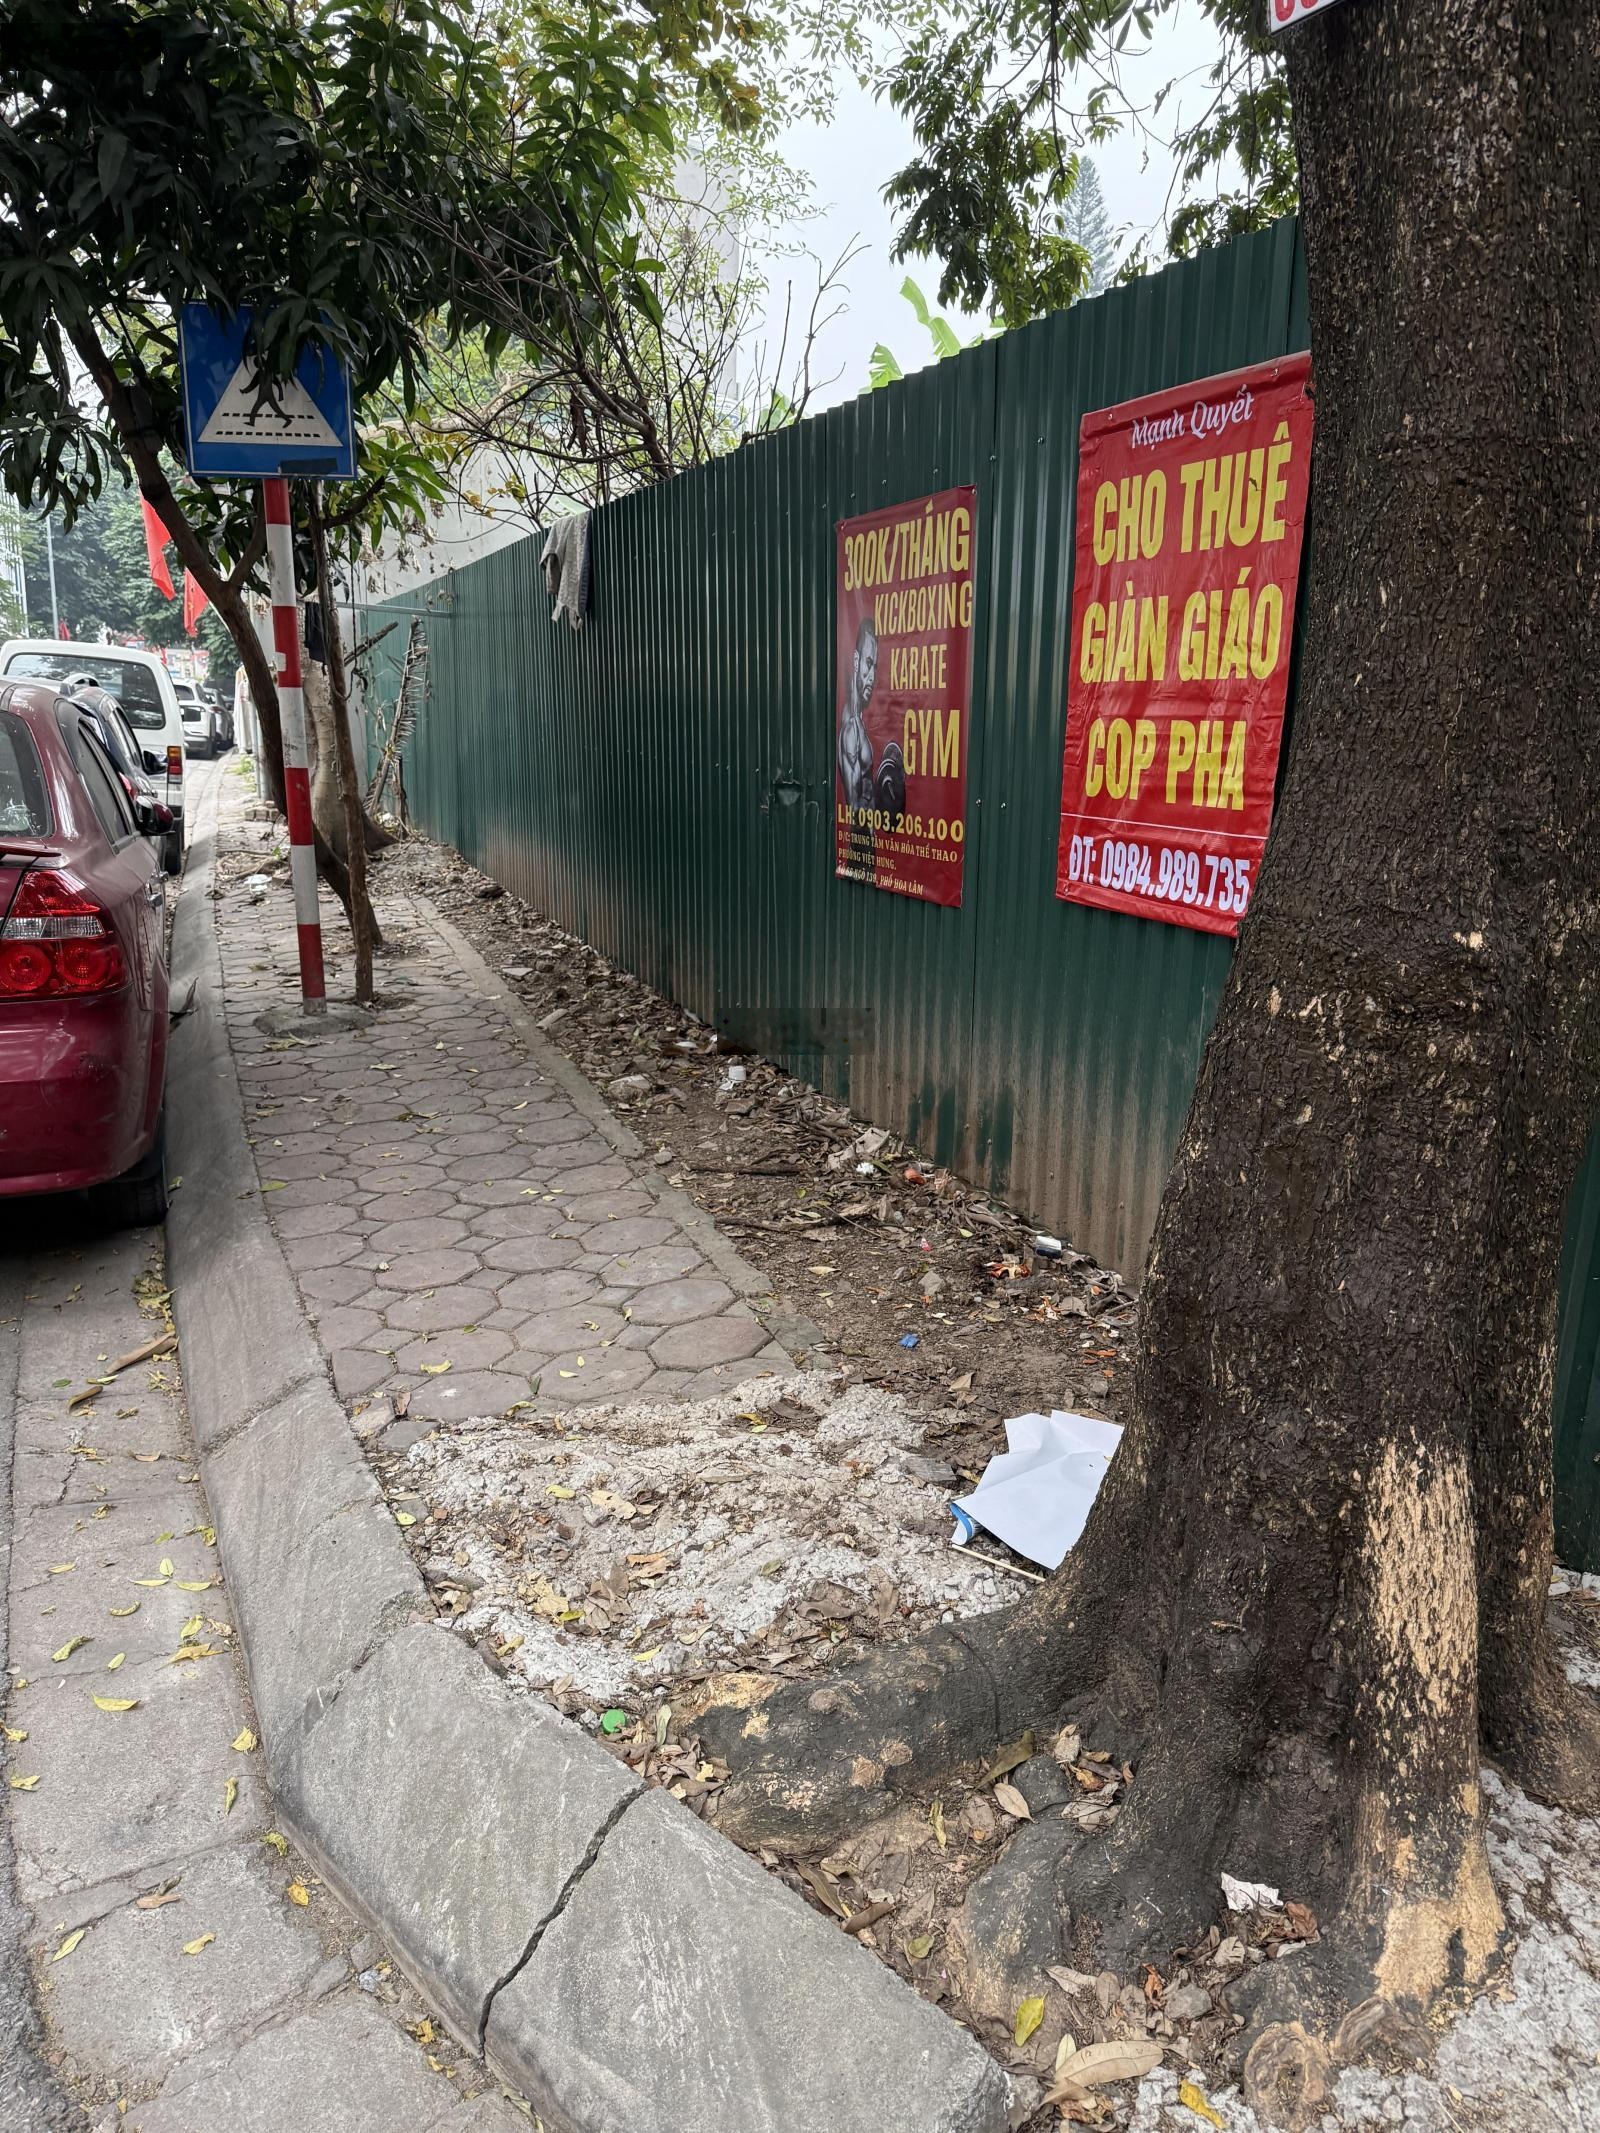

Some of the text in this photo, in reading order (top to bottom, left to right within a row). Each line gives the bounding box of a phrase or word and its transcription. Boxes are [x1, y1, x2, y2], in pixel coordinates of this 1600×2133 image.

[1131, 384, 1255, 451] Mạnh Quyết
[1093, 421, 1293, 566] CHO THUÊ
[844, 499, 970, 592] 300K/THÁNG
[874, 580, 973, 637] KICKBOXING
[1080, 567, 1284, 684] GIÀN GIÁO
[890, 643, 948, 691] KARATE
[903, 708, 961, 779] GYM
[1085, 717, 1247, 811] COP PHA
[837, 803, 964, 843] LH: 0903.206.100
[851, 832, 870, 846] TRUNG
[931, 848, 959, 863] THAO
[1068, 834, 1250, 914] ĐT: 0984.989.735
